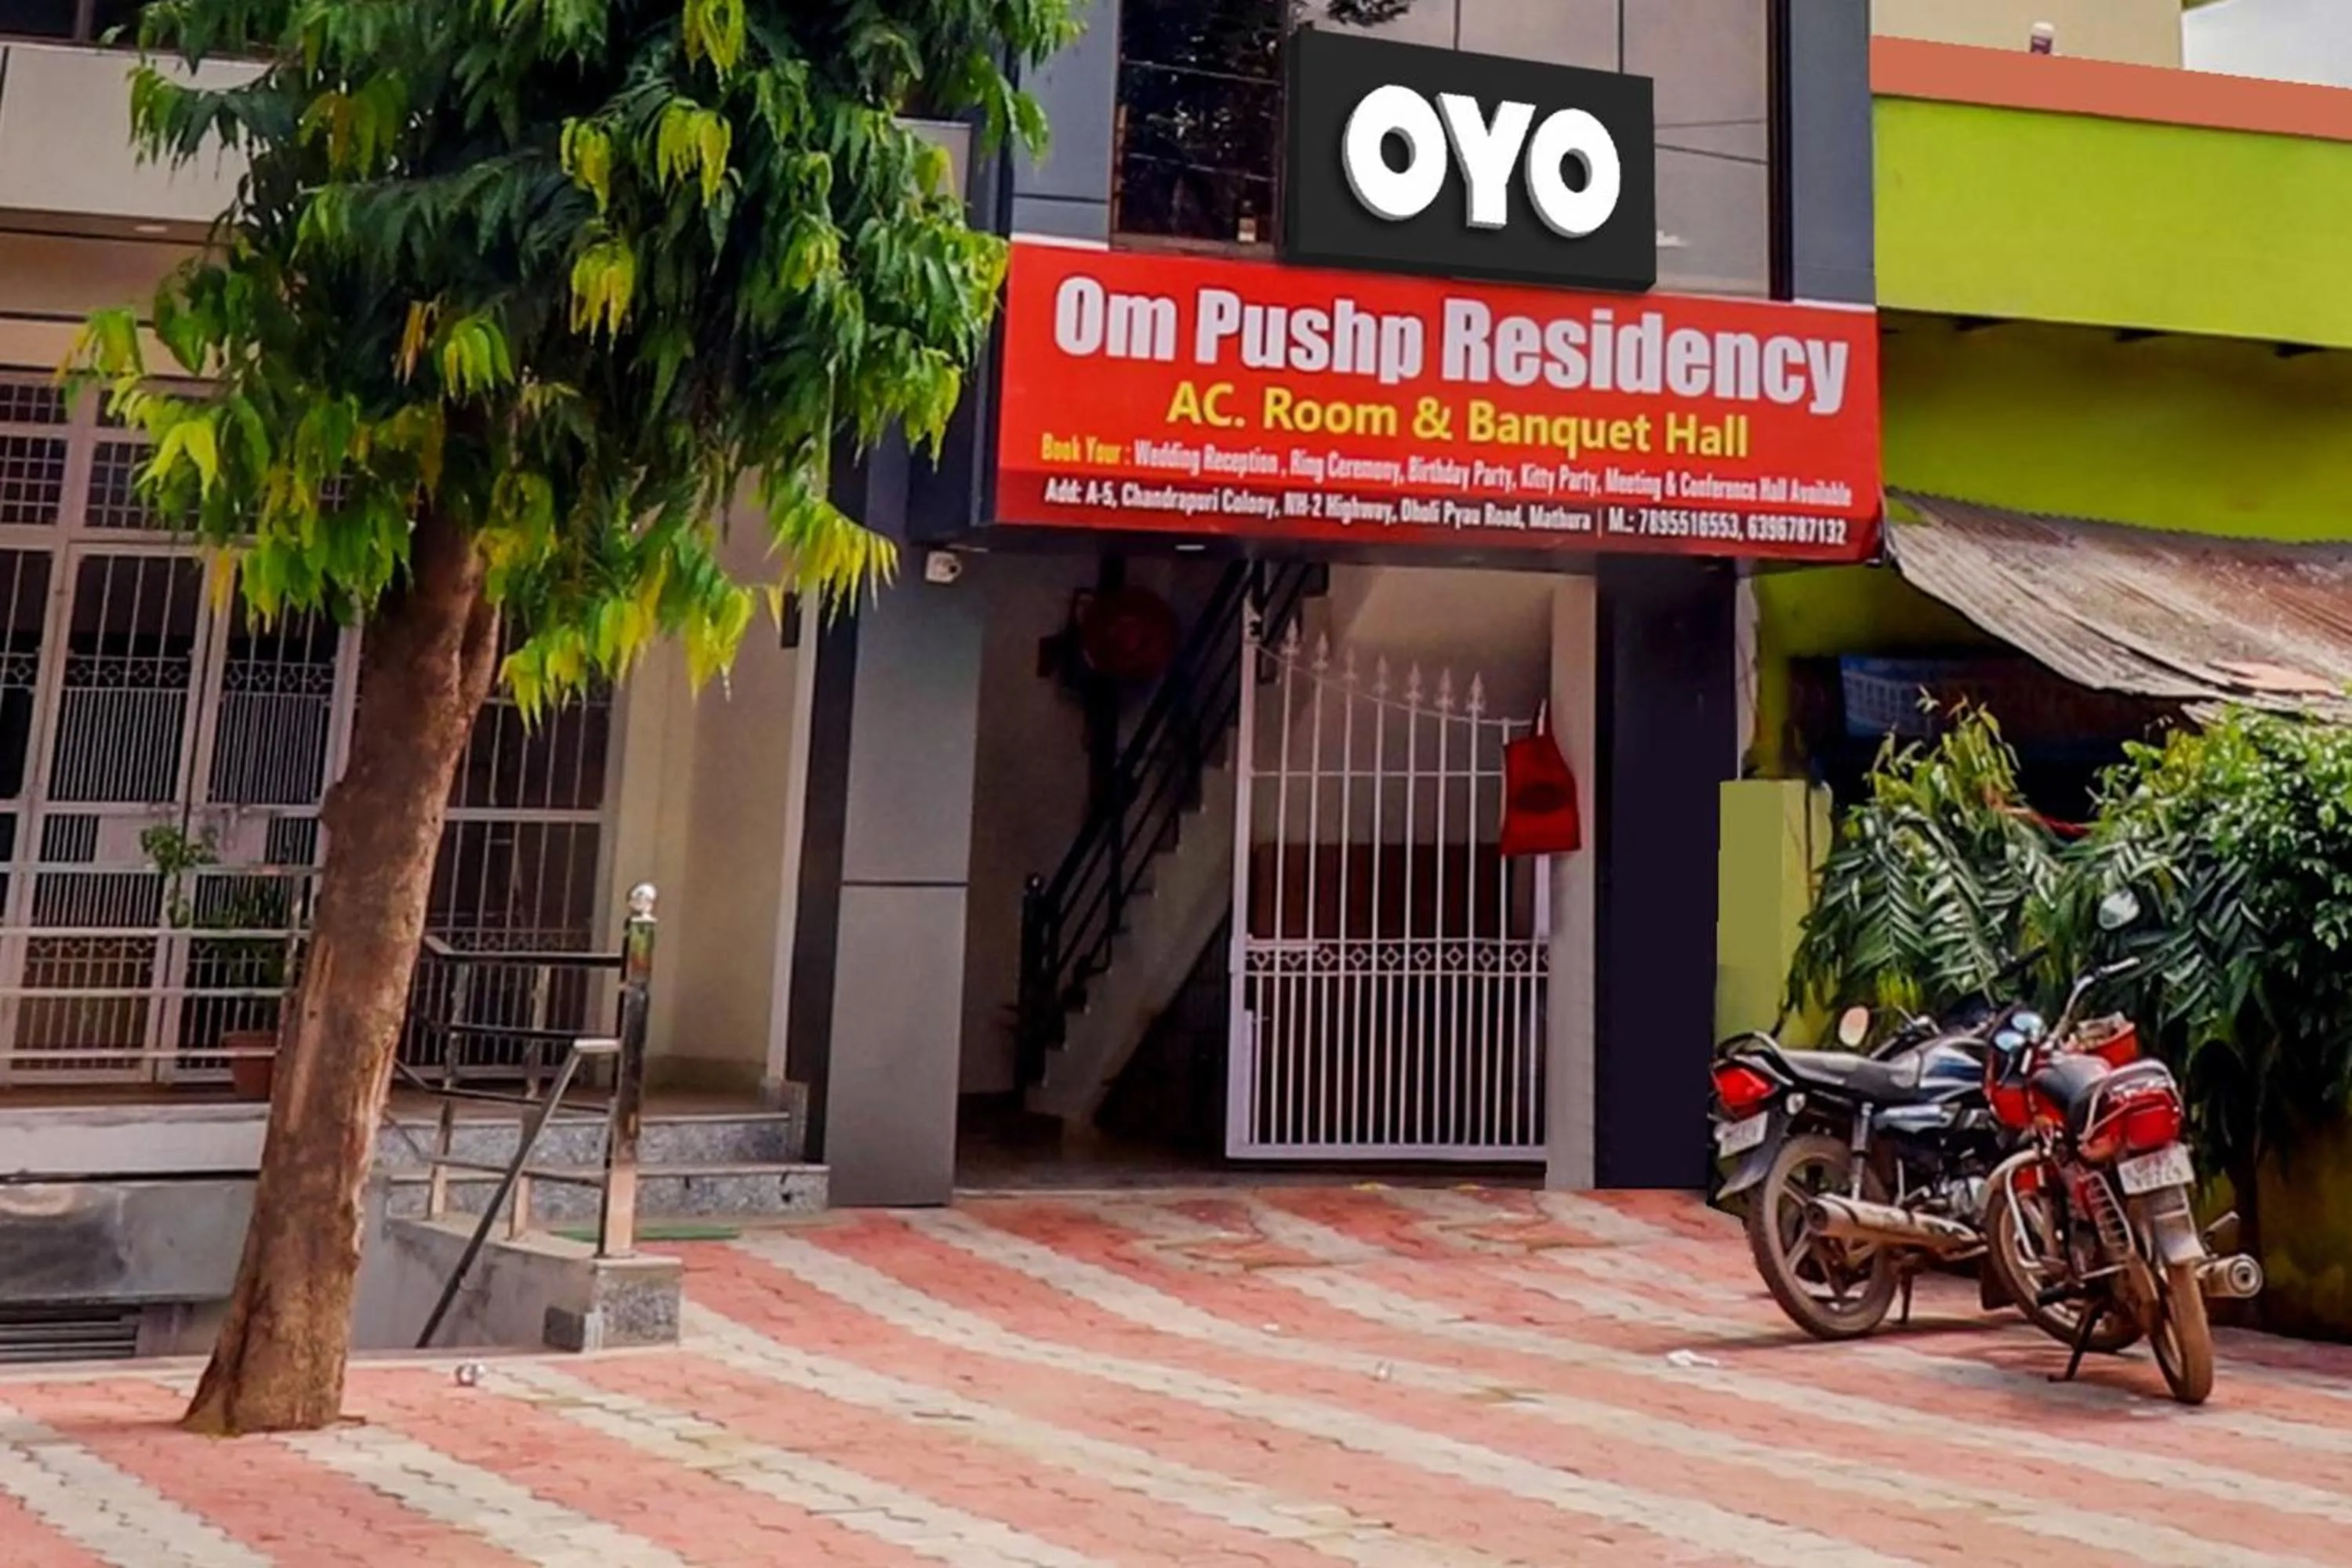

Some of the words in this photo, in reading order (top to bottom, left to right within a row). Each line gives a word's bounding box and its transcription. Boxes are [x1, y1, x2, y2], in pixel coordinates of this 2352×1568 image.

[1341, 84, 1621, 238] OYO
[1054, 276, 1176, 361] Om
[1195, 288, 1424, 384] Pushp
[1441, 298, 1849, 415] Residency
[1166, 380, 1246, 427] AC.
[1263, 387, 1397, 437] Room
[1413, 396, 1453, 441] &
[1468, 400, 1651, 459] Banquet
[1666, 412, 1748, 458] Hall
[1042, 433, 1080, 461] Book
[1134, 439, 1200, 476] Wedding
[1203, 443, 1278, 478] Reception
[1290, 448, 1323, 484] Ring
[1328, 450, 1404, 487] Ceremony,
[1408, 455, 1469, 491] Birthday
[1520, 463, 1554, 495] Kitty
[1606, 466, 1662, 502] Meeting
[1664, 470, 1676, 496] &
[1680, 472, 1756, 500] Conference
[1760, 477, 1787, 502] Hall
[1791, 478, 1852, 507] Available
[1121, 481, 1218, 516] Chandrapuri
[1284, 491, 1322, 517] NH-2
[1484, 502, 1525, 529] Road,
[1530, 504, 1591, 530] Mathura
